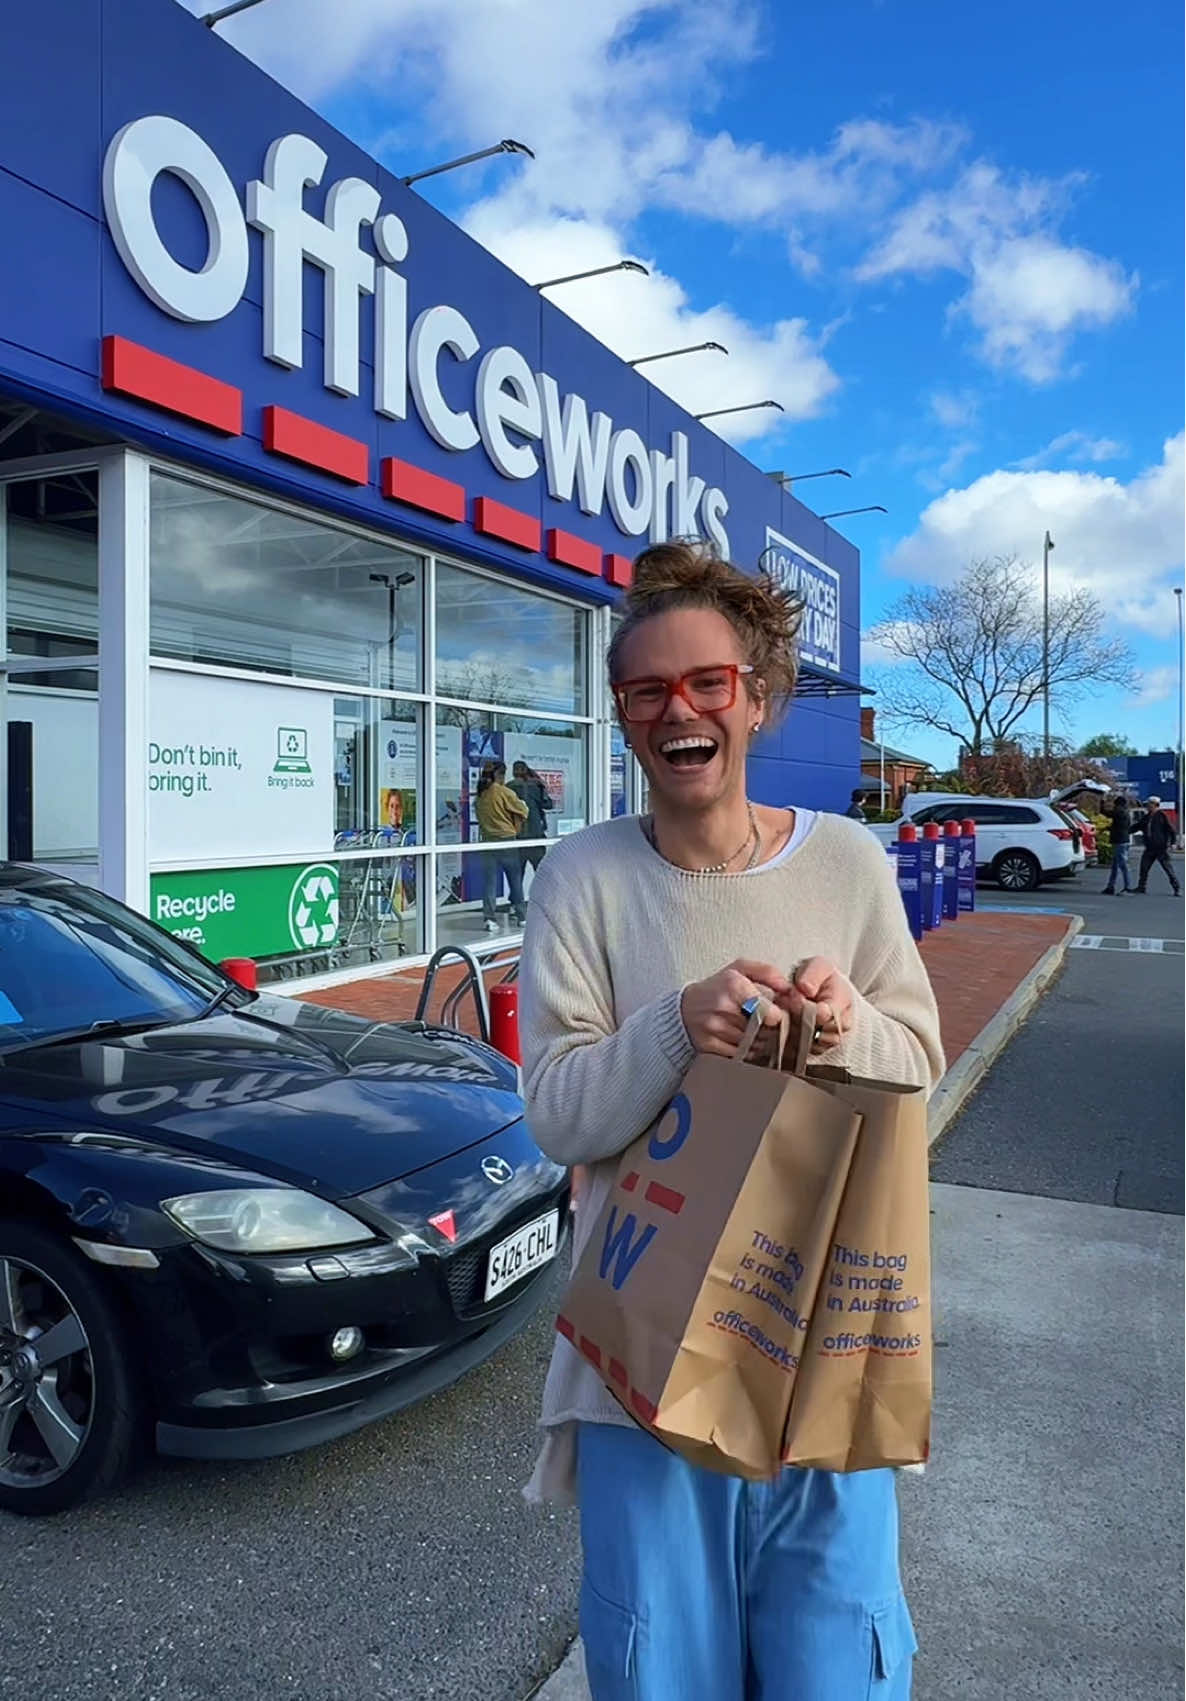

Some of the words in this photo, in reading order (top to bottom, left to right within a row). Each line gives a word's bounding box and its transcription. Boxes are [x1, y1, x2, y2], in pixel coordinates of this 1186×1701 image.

[800, 568, 837, 618] PRICES
[814, 610, 837, 653] DAY
[200, 745, 225, 766] bin
[228, 747, 242, 770] it,
[198, 772, 212, 791] it.
[267, 775, 288, 790] Bring
[295, 776, 314, 788] back
[157, 889, 236, 922] Recycle
[171, 926, 206, 945] ere.
[752, 1230, 783, 1259] This
[739, 1253, 756, 1271] is
[833, 1244, 870, 1268] This
[872, 1250, 908, 1273] bag
[730, 1272, 747, 1293] in
[830, 1270, 844, 1288] is
[848, 1275, 904, 1292] made
[826, 1293, 844, 1313] in
[847, 1295, 920, 1314] Australia
[713, 1310, 801, 1370] officeworks
[823, 1332, 922, 1350] officeworks
